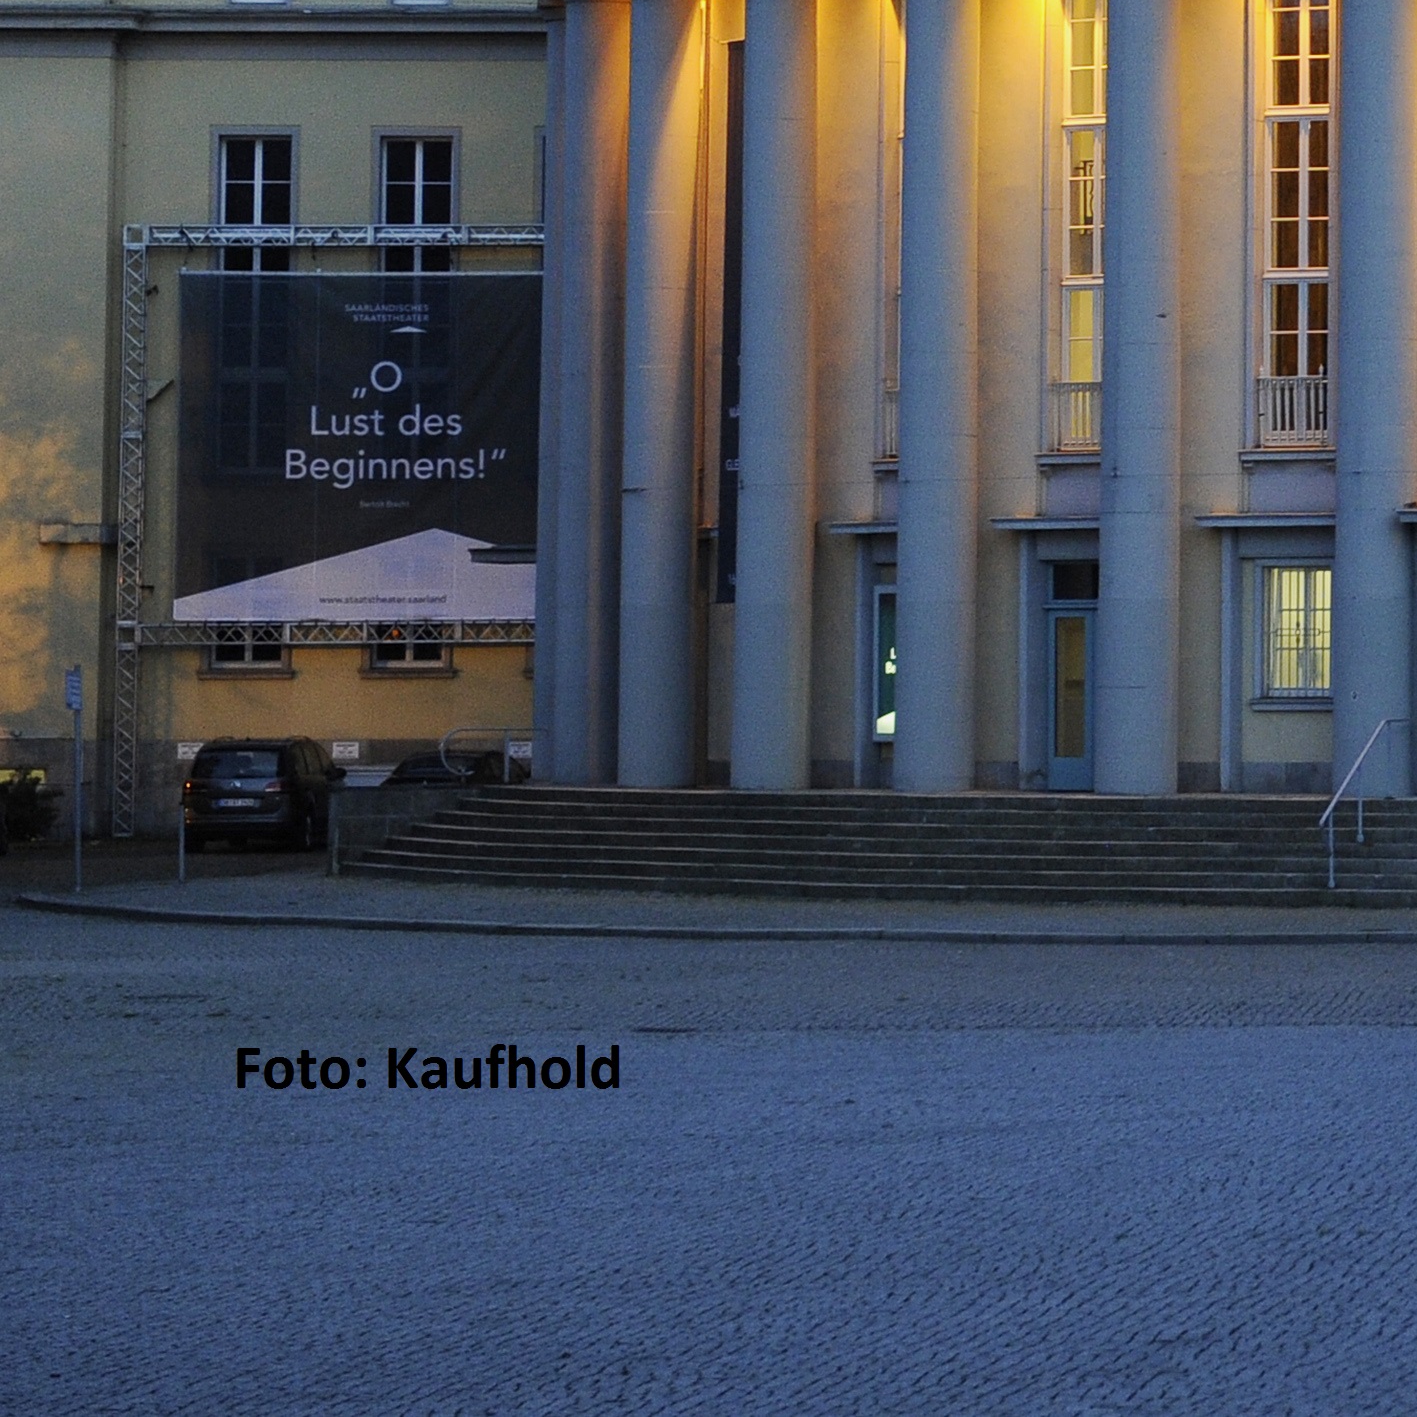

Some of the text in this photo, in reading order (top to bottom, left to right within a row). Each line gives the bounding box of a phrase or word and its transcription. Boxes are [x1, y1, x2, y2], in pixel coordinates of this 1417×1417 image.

[345, 303, 429, 313] SAARLÄNDISCHES
[352, 313, 429, 323] STAATSTHEATER
[310, 403, 463, 437] Lust des
